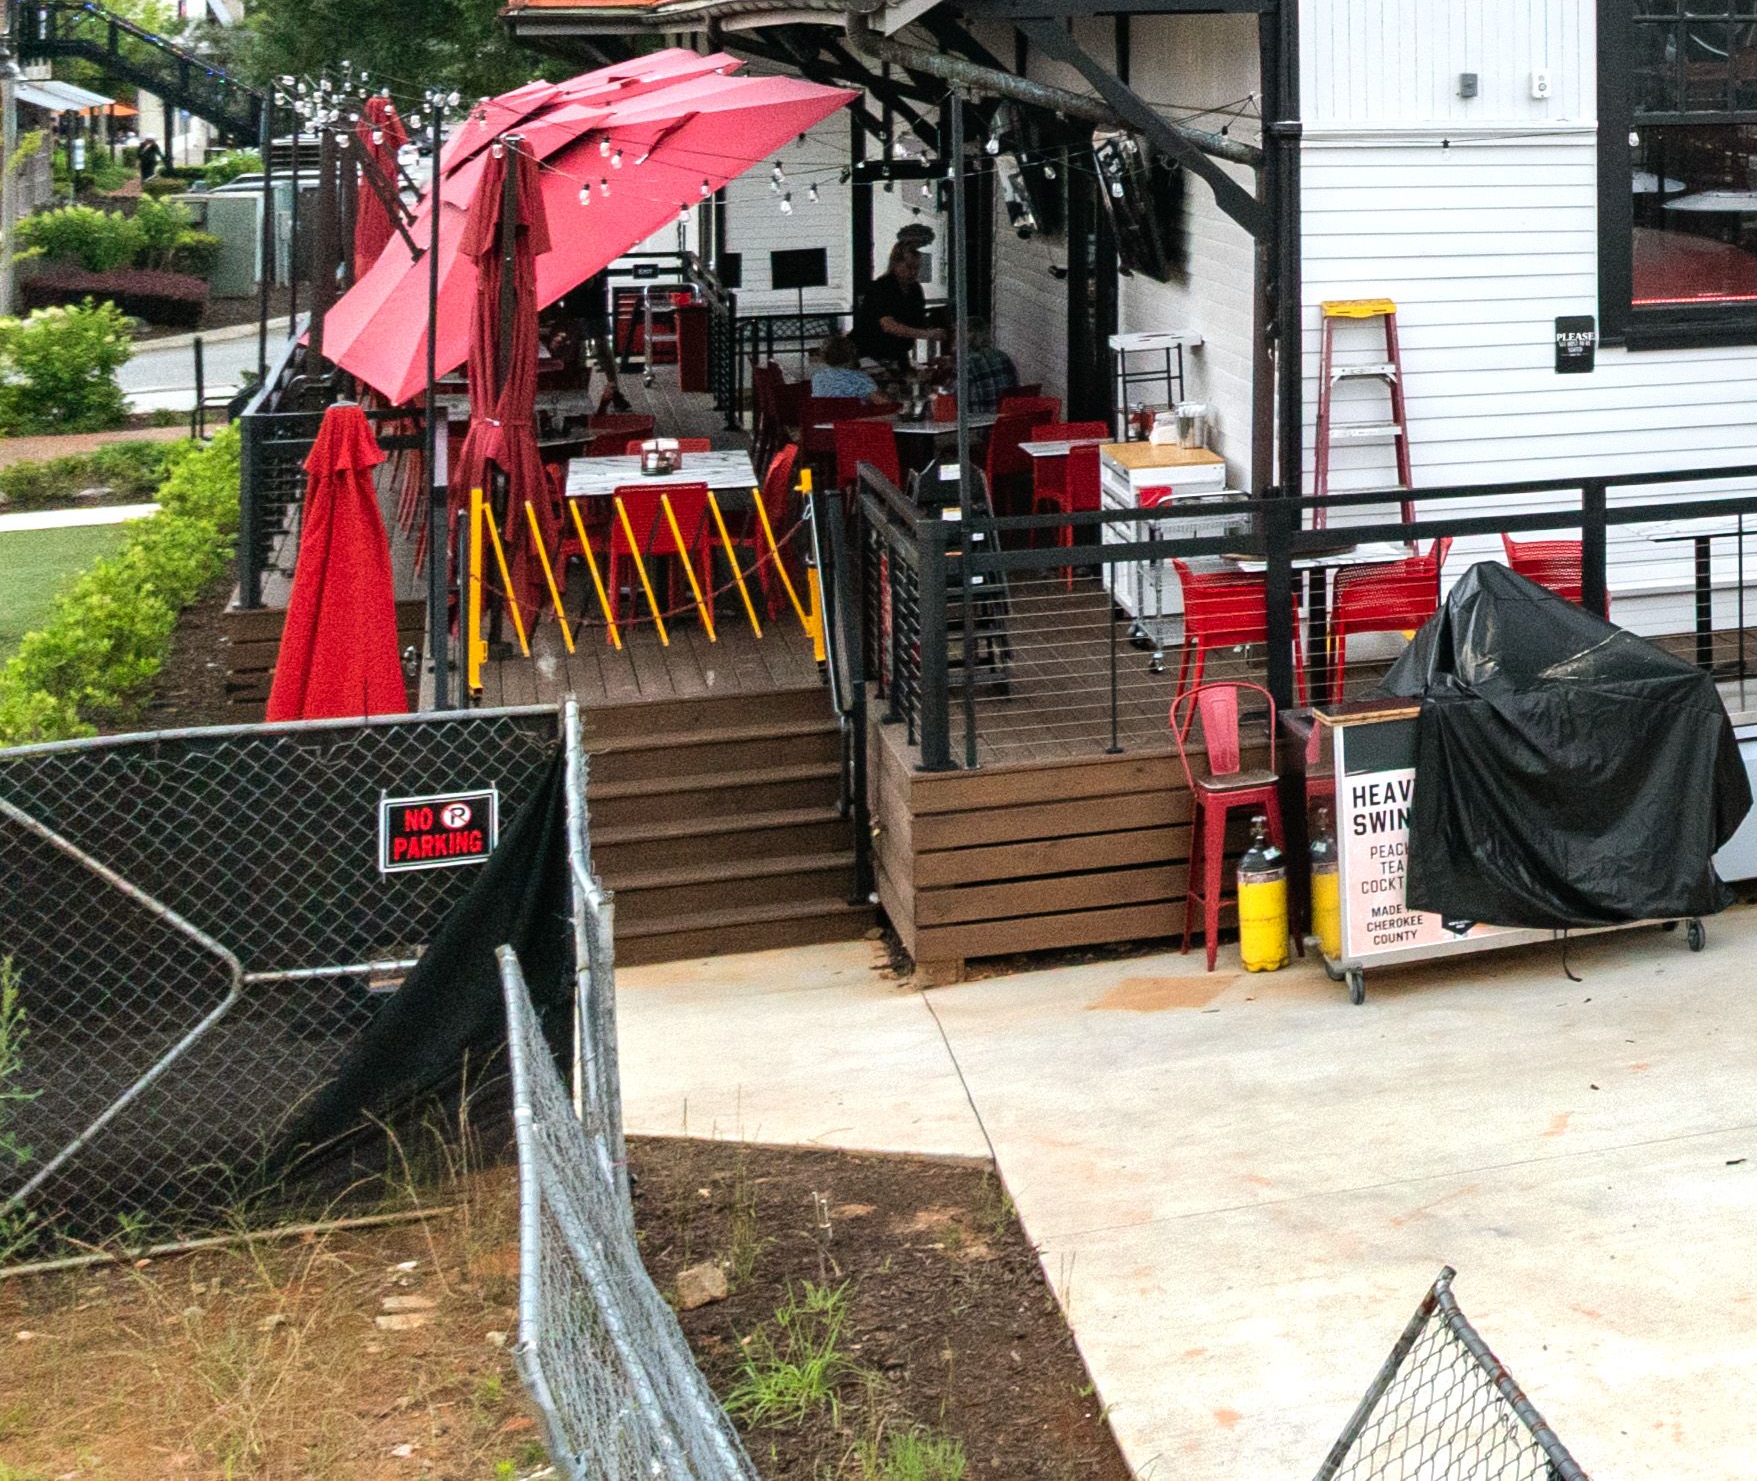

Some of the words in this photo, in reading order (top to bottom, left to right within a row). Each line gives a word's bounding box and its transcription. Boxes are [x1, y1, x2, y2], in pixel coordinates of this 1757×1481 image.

[1556, 332, 1595, 342] PLEASE
[1352, 778, 1415, 809] HEAV
[404, 807, 434, 832] NO
[393, 830, 483, 861] PARKING
[1381, 860, 1405, 874] TEA
[1361, 878, 1405, 895] COCKT
[1371, 904, 1403, 918] MADE
[1366, 915, 1424, 933] CHEROKEE
[1373, 930, 1419, 946] COUNTY
